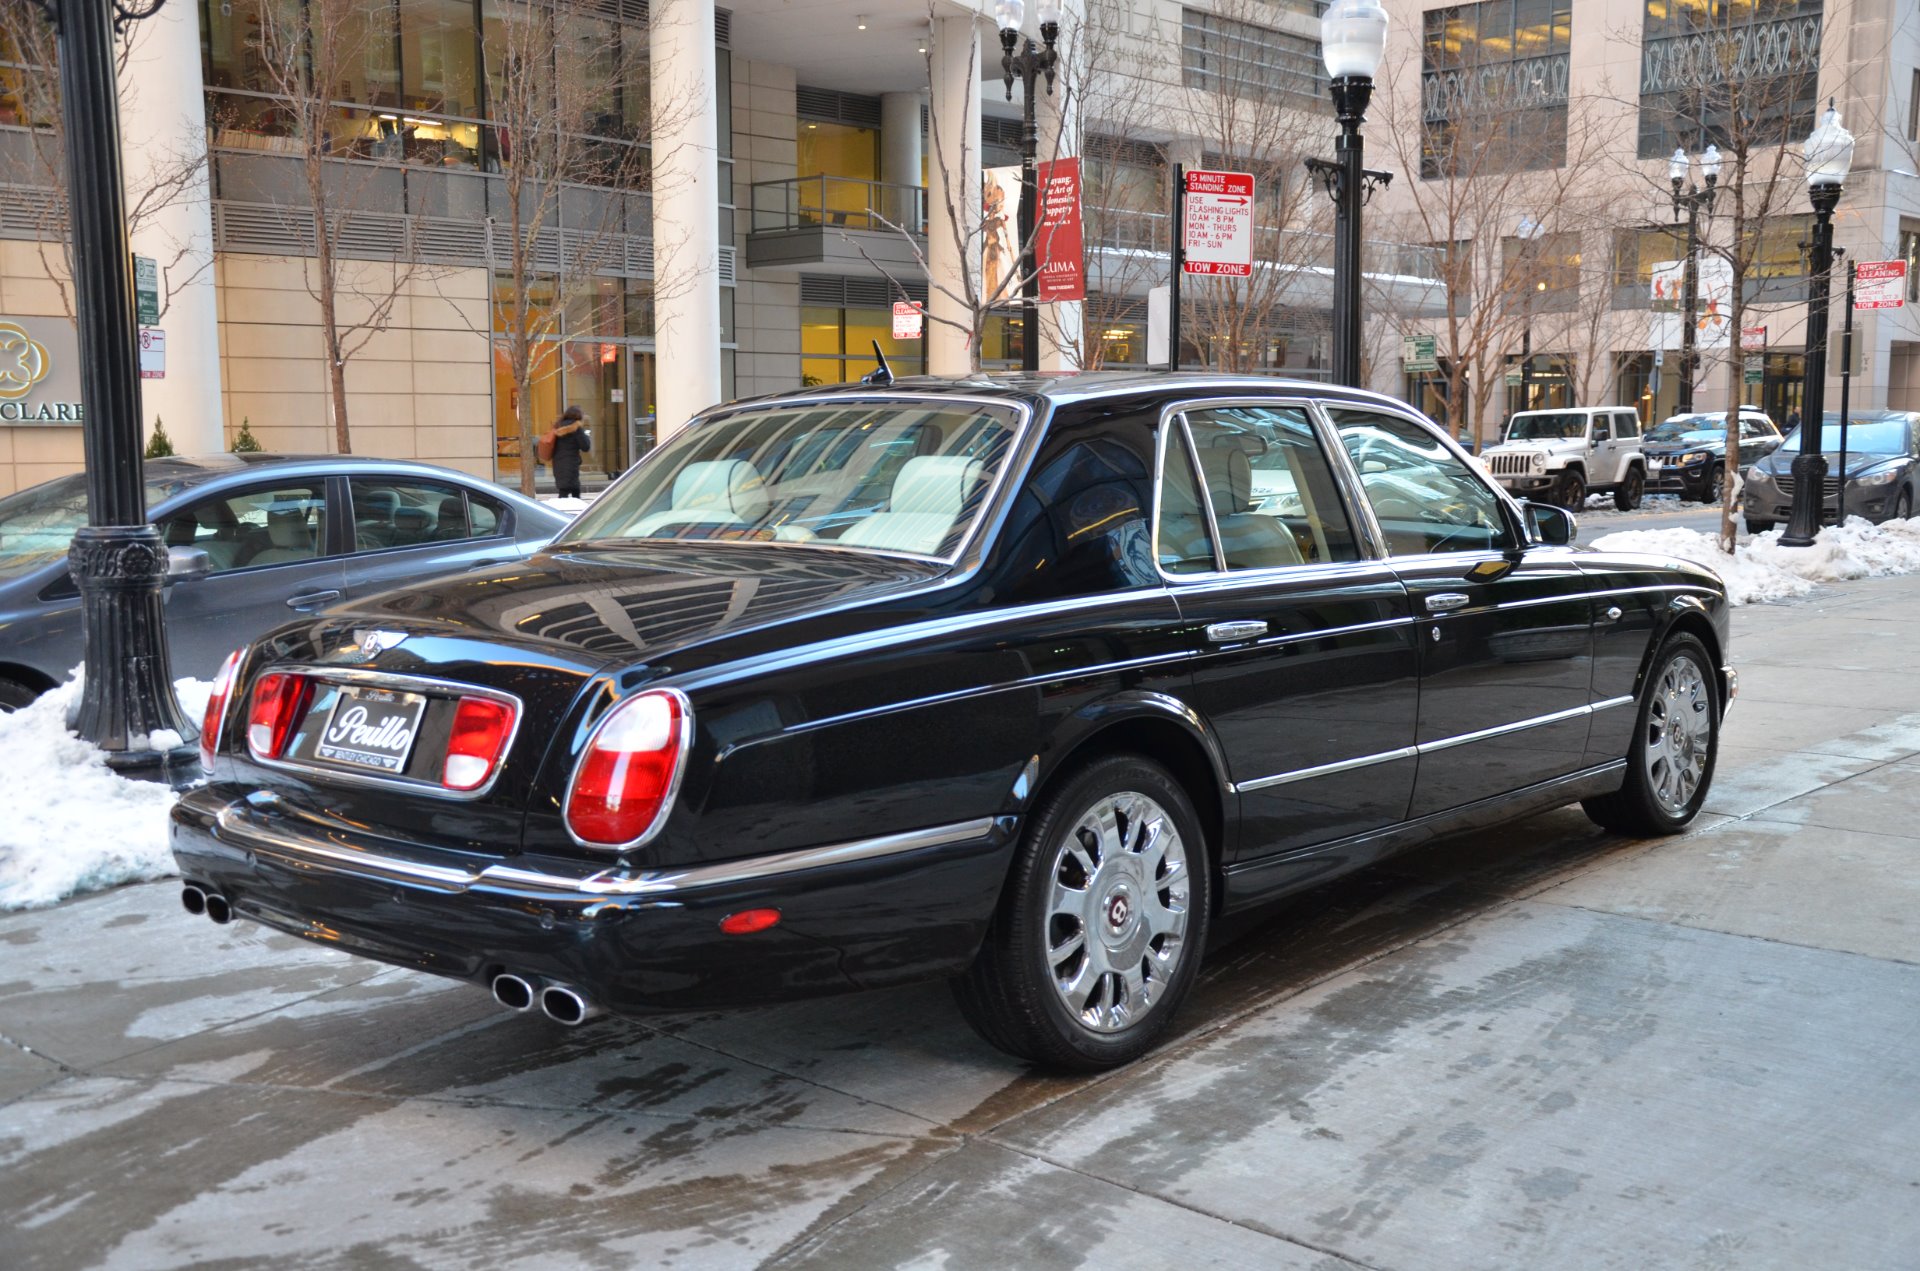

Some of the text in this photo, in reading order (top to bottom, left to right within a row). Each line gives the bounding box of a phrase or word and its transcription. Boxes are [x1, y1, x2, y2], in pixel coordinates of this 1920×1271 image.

[1200, 174, 1225, 183] MINUTE
[1066, 184, 1074, 194] of
[1190, 182, 1246, 193] STANDING ZONE
[1040, 196, 1075, 206] Idonesin
[1189, 205, 1223, 214] FLASHING
[1213, 224, 1237, 232] THURS
[1044, 261, 1075, 274] LUMA
[1188, 262, 1245, 274] TOW ZONE
[1860, 269, 1899, 278] CLEANING
[366, 690, 395, 702] Perillo
[328, 706, 410, 750] Perillo
